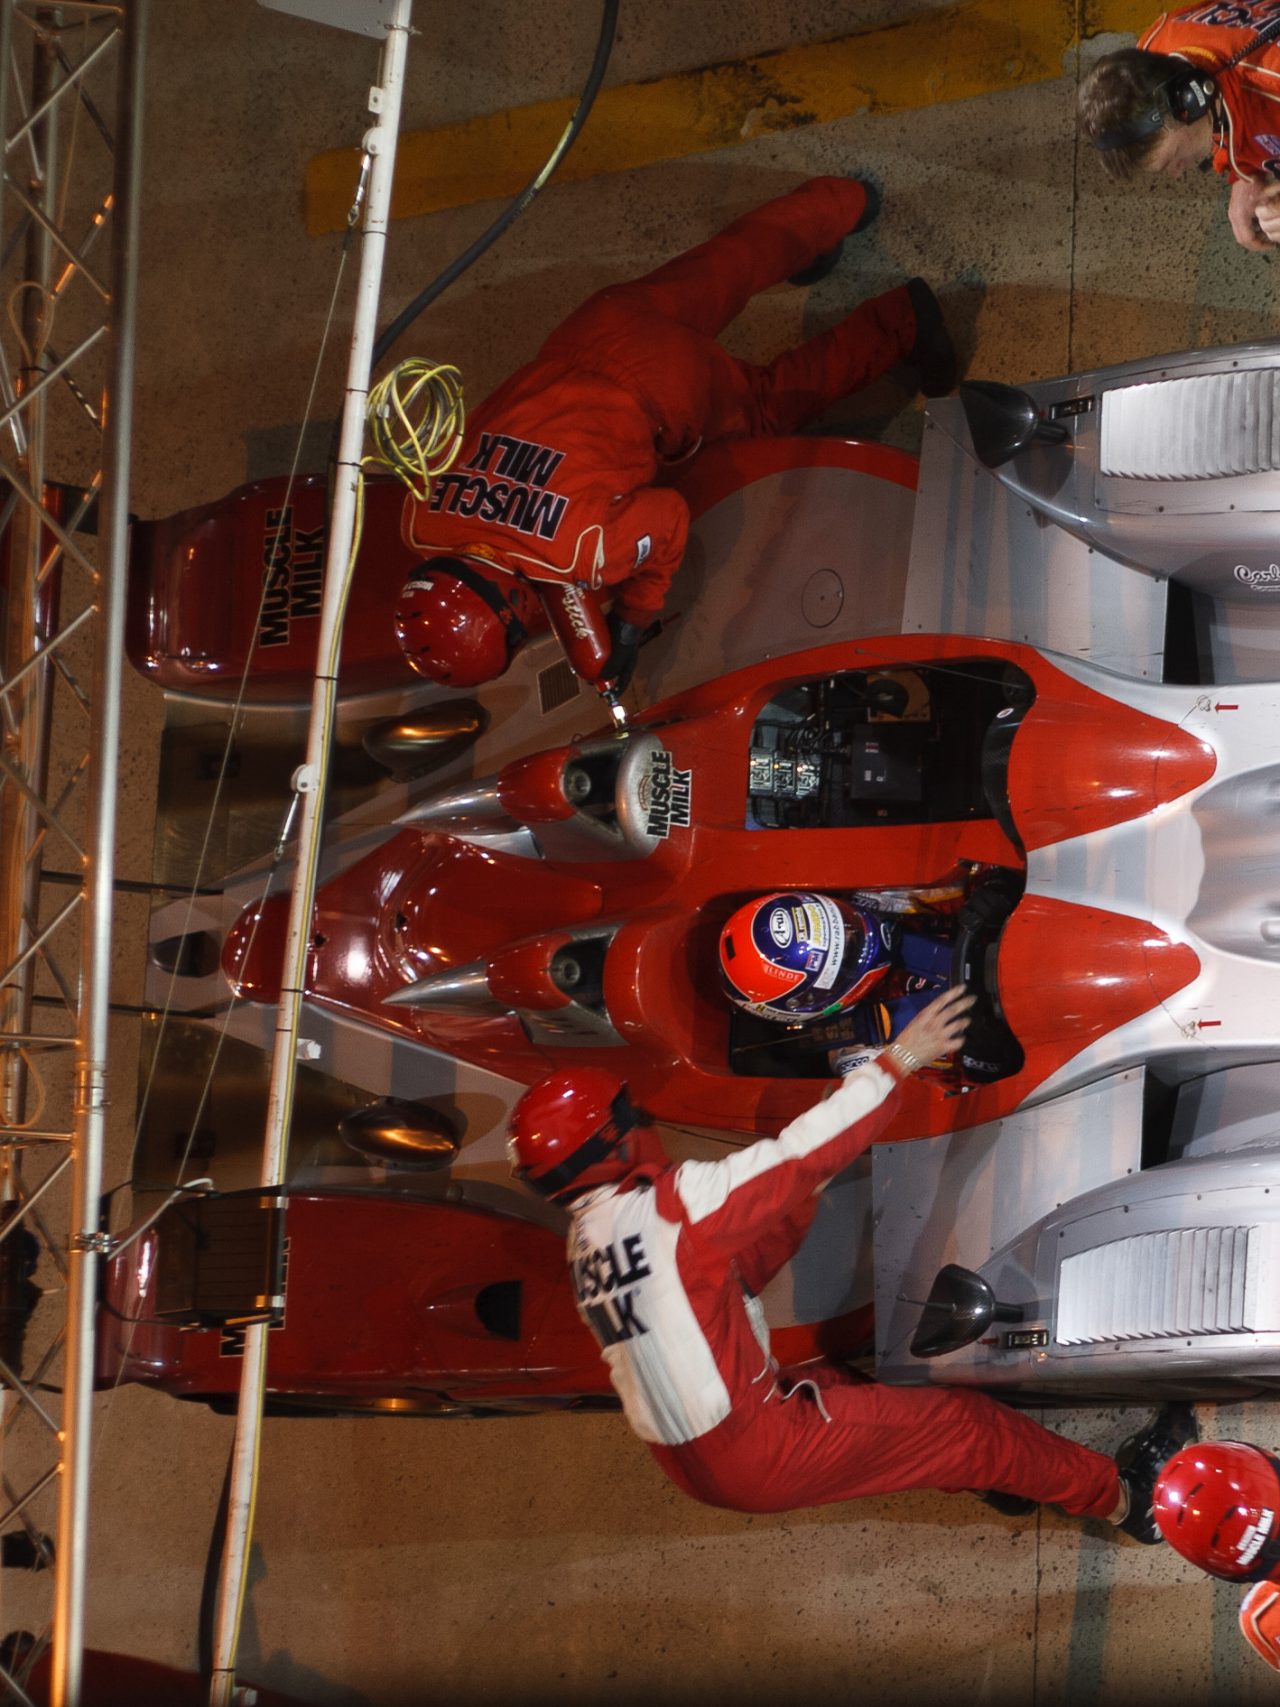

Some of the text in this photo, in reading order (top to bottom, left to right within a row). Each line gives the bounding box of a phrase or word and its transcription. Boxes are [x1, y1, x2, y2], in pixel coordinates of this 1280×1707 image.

[463, 433, 567, 489] MILK
[428, 473, 569, 541] MUSCLE
[259, 504, 295, 649] MUSCLE
[290, 524, 325, 619] MILK
[646, 751, 672, 839] MUSCLE
[669, 767, 692, 827] MILK
[773, 910, 789, 944] Arai
